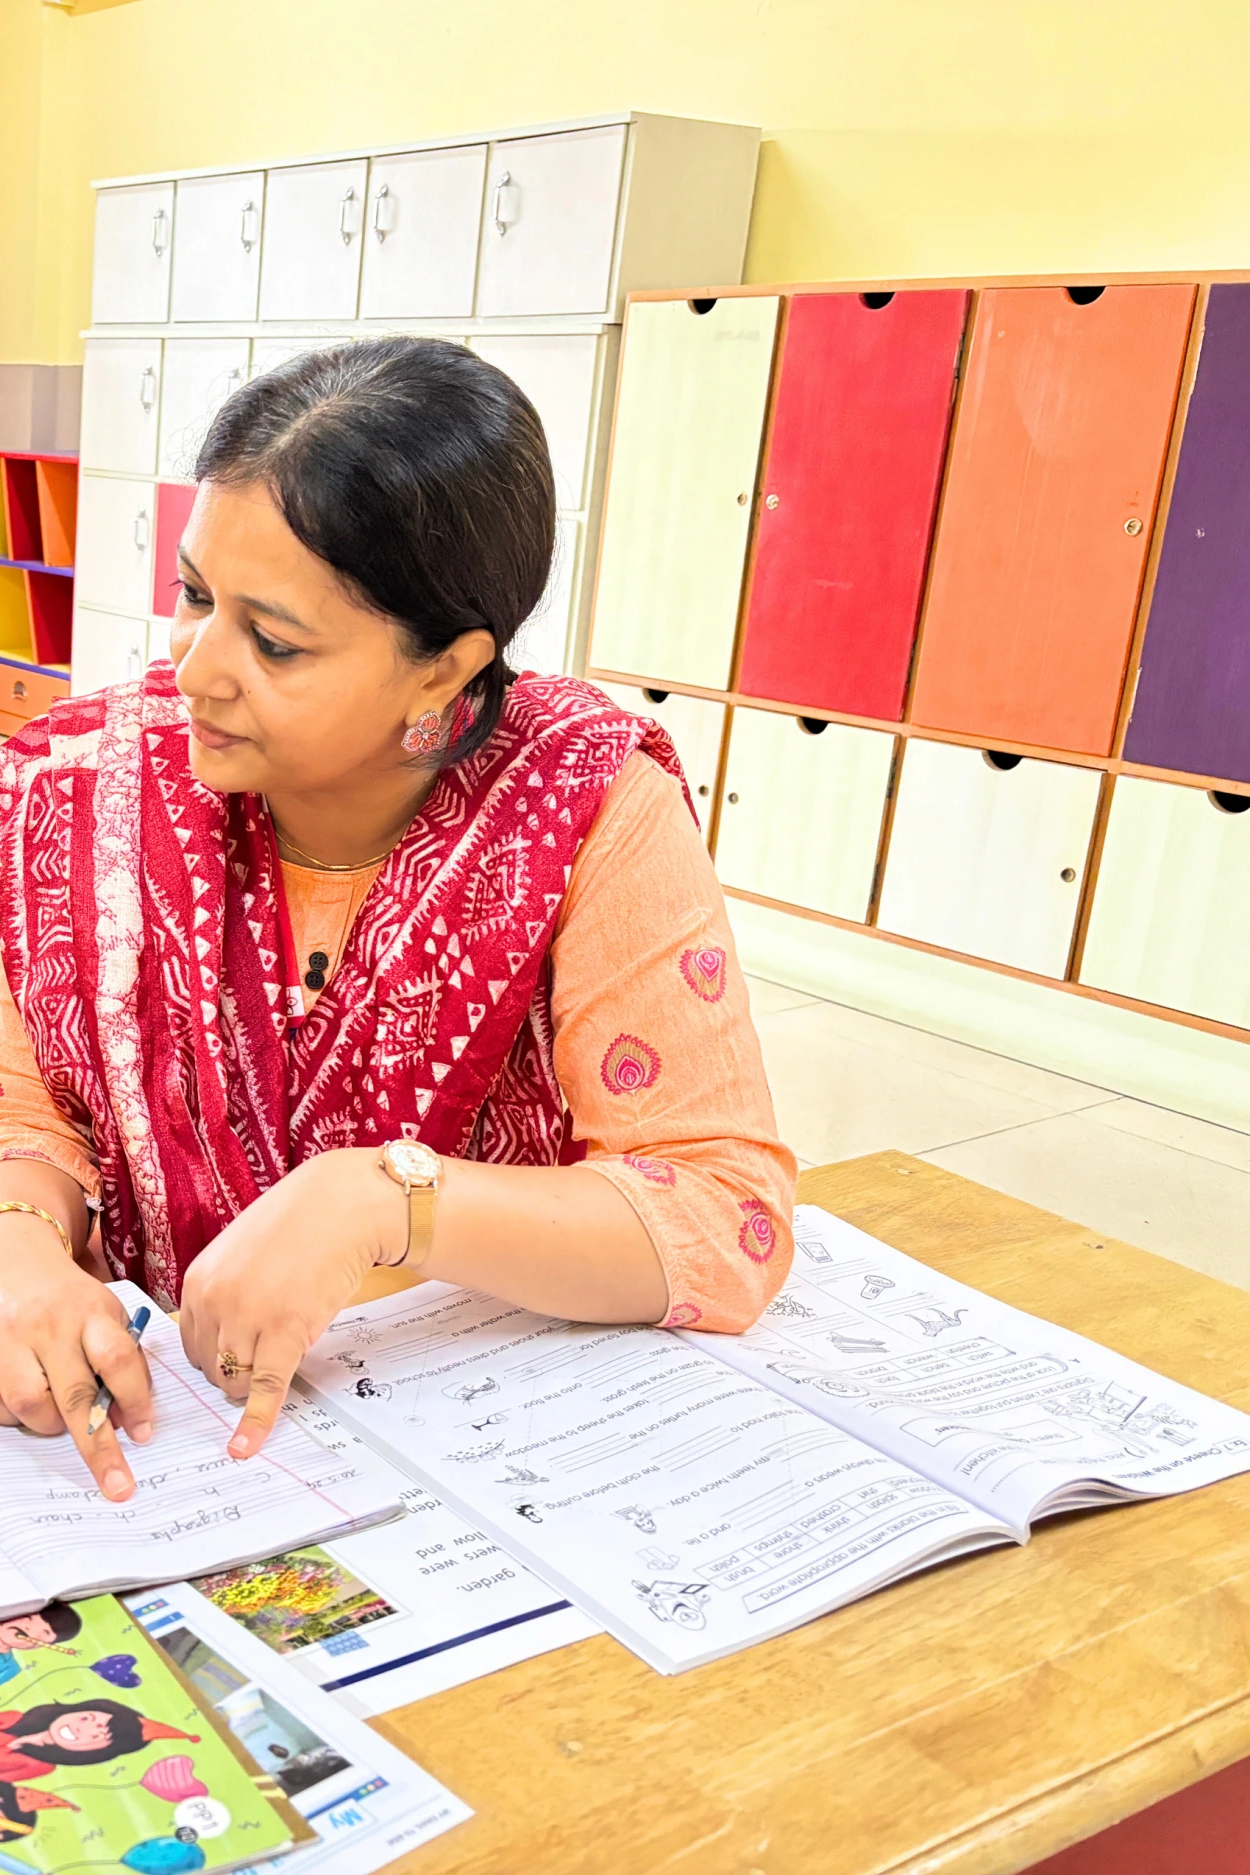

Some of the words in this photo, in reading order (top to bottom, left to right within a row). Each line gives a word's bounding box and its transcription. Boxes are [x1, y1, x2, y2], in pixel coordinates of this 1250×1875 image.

[442, 1297, 473, 1311] moves
[408, 1313, 424, 1324] the
[423, 1307, 443, 1319] with
[504, 1307, 522, 1320] the
[387, 1319, 409, 1330] sun.
[480, 1315, 505, 1327] water
[450, 1331, 461, 1339] a
[460, 1323, 481, 1334] with
[533, 1325, 556, 1339] your
[617, 1323, 638, 1339] boy
[507, 1333, 535, 1349] shoes
[591, 1330, 621, 1348] fished
[488, 1345, 510, 1357] and
[578, 1342, 594, 1352] for
[649, 1346, 672, 1358] glass
[945, 1341, 981, 1355] cheetah
[464, 1352, 490, 1365] dress
[903, 1354, 938, 1366] wrench
[966, 1351, 994, 1362] switch
[436, 1357, 467, 1375] neatly
[667, 1367, 680, 1376] on
[854, 1365, 889, 1377] branch
[920, 1362, 951, 1374] bench
[998, 1365, 1022, 1378] write
[1019, 1360, 1039, 1371] and
[1036, 1365, 1058, 1376] Look
[390, 1371, 427, 1386] school.
[425, 1369, 438, 1378] to
[649, 1371, 669, 1384] the
[874, 1375, 900, 1385] torch
[983, 1371, 1001, 1383] the
[1010, 1372, 1027, 1384] the
[1025, 1370, 1038, 1379] at
[625, 1379, 651, 1394] fresh
[938, 1383, 957, 1394] the
[963, 1375, 985, 1388] word
[980, 1376, 1012, 1392] picture
[1058, 1376, 1096, 1392] Digraphs
[560, 1382, 583, 1396] onto
[599, 1388, 628, 1404] grass.
[713, 1390, 737, 1402] were
[916, 1386, 942, 1399] blank
[947, 1388, 964, 1400] say
[962, 1386, 983, 1397] and
[1042, 1385, 1060, 1396] are
[517, 1396, 546, 1411] floor.
[542, 1390, 563, 1403] the
[931, 1394, 949, 1404] the
[994, 1397, 1012, 1409] put
[1010, 1390, 1039, 1405] letters
[623, 1397, 650, 1411] takes
[685, 1399, 714, 1414] many
[959, 1402, 996, 1417] together
[605, 1408, 625, 1422] the
[659, 1409, 689, 1427] turtles
[762, 1410, 788, 1422] tailor
[576, 1415, 608, 1435] sheep
[645, 1423, 660, 1432] on
[730, 1425, 743, 1435] to
[740, 1418, 763, 1430] had
[352, 1436, 363, 1444] a
[546, 1432, 567, 1445] the
[565, 1429, 579, 1437] to
[628, 1427, 648, 1441] the
[504, 1438, 549, 1460] meadow
[1182, 1447, 1223, 1463] Cheese
[753, 1455, 771, 1467] my
[842, 1458, 875, 1473] always
[960, 1447, 999, 1476] kitchen!
[1169, 1460, 1184, 1468] on
[641, 1464, 661, 1477] the
[726, 1464, 756, 1481] teeth
[815, 1468, 844, 1483] wears
[1152, 1464, 1173, 1474] the
[615, 1471, 642, 1487] cloth
[699, 1478, 730, 1494] twice
[804, 1478, 815, 1488] a
[582, 1479, 617, 1500] before
[690, 1490, 701, 1499] a
[857, 1487, 879, 1501] shirt
[543, 1490, 583, 1512] cutting.
[666, 1495, 691, 1508] day.
[866, 1492, 899, 1511] splash
[114, 1509, 136, 1524] ch
[800, 1503, 842, 1529] crashed
[886, 1512, 921, 1534] blanks
[150, 1505, 241, 1542] Digraphs
[708, 1523, 732, 1537] and
[821, 1515, 852, 1536] shrink
[453, 1531, 488, 1548] llow
[682, 1535, 702, 1547] tie.
[699, 1532, 710, 1540] a
[754, 1529, 794, 1554] shrimps
[865, 1529, 888, 1547] with
[415, 1543, 446, 1560] and
[463, 1545, 503, 1561] wers
[773, 1541, 803, 1560] shore
[848, 1541, 868, 1556] the
[418, 1559, 459, 1576] were
[709, 1555, 741, 1573] polish
[788, 1552, 849, 1587] appropriate
[455, 1567, 516, 1593] garden.
[723, 1566, 756, 1584] brush
[756, 1583, 789, 1602] word.
[328, 1807, 364, 1831] My
